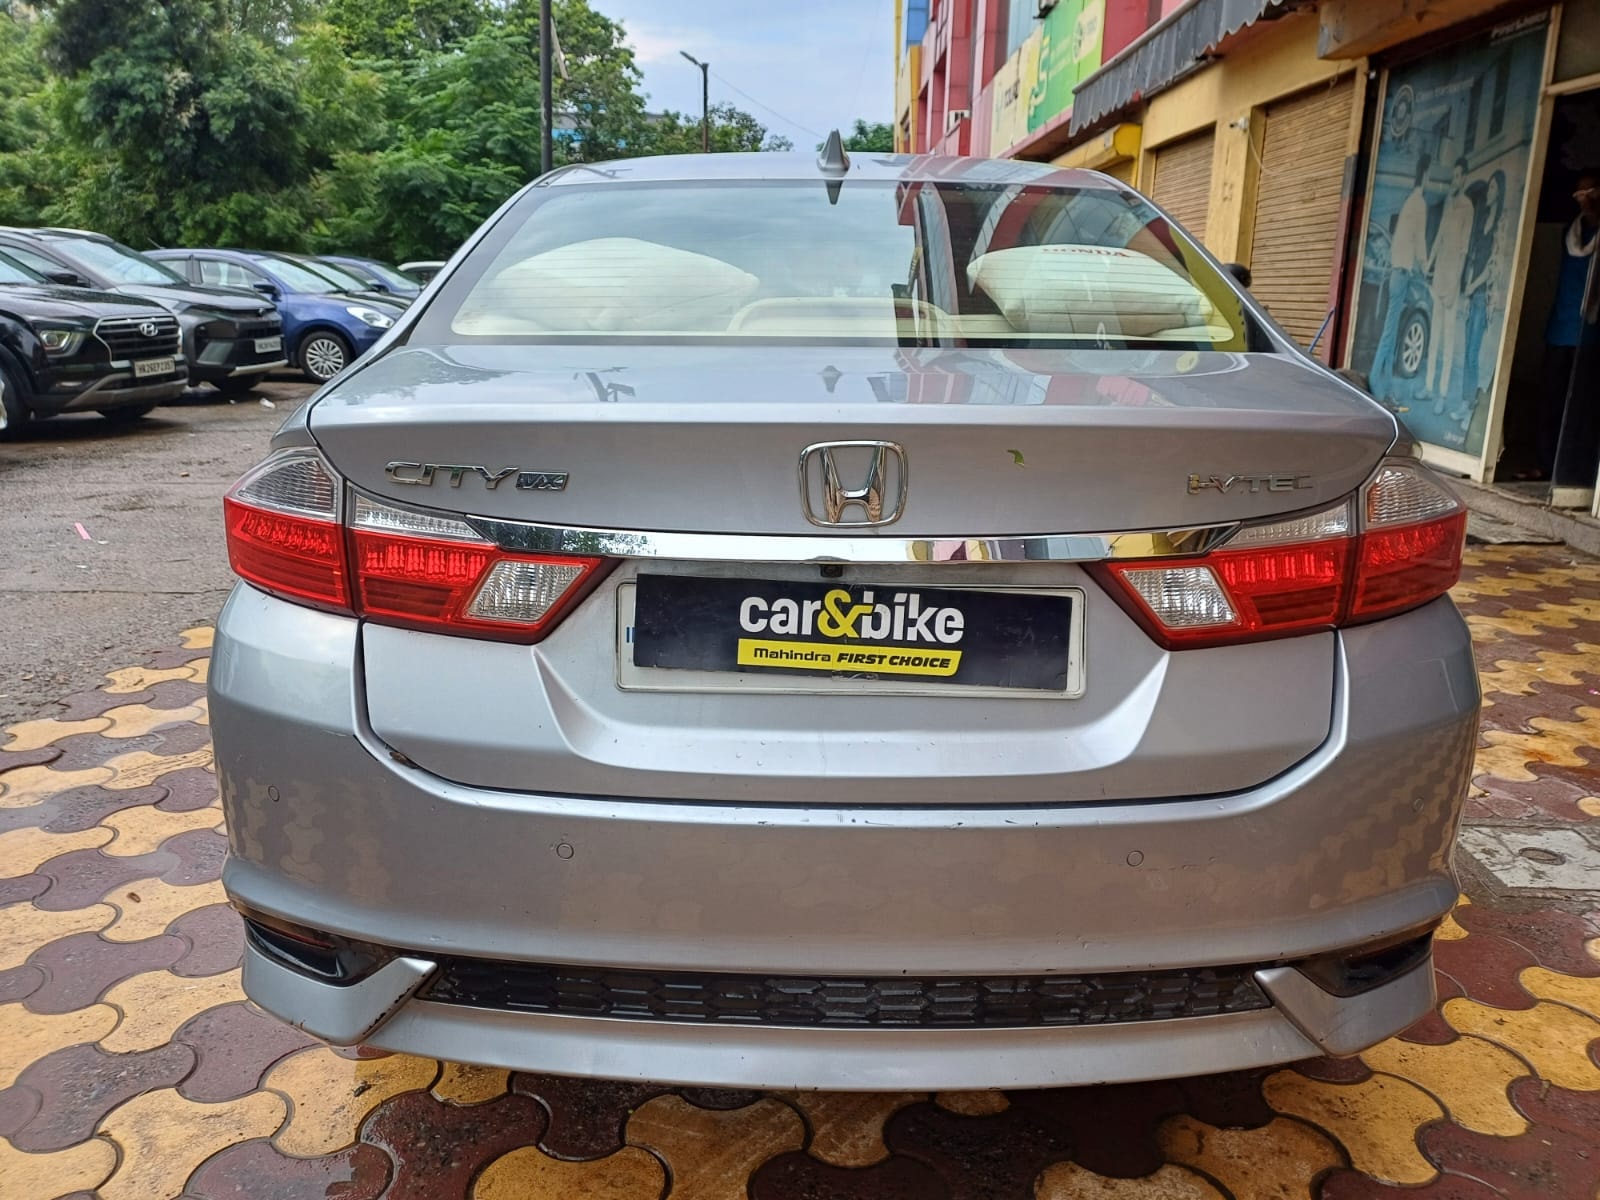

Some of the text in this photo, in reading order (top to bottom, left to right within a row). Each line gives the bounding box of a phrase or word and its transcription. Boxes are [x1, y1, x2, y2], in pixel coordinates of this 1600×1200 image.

[385, 462, 519, 489] CITY
[739, 589, 965, 644] car&bike
[753, 647, 952, 669] Mahindra FIRST CHOICE
